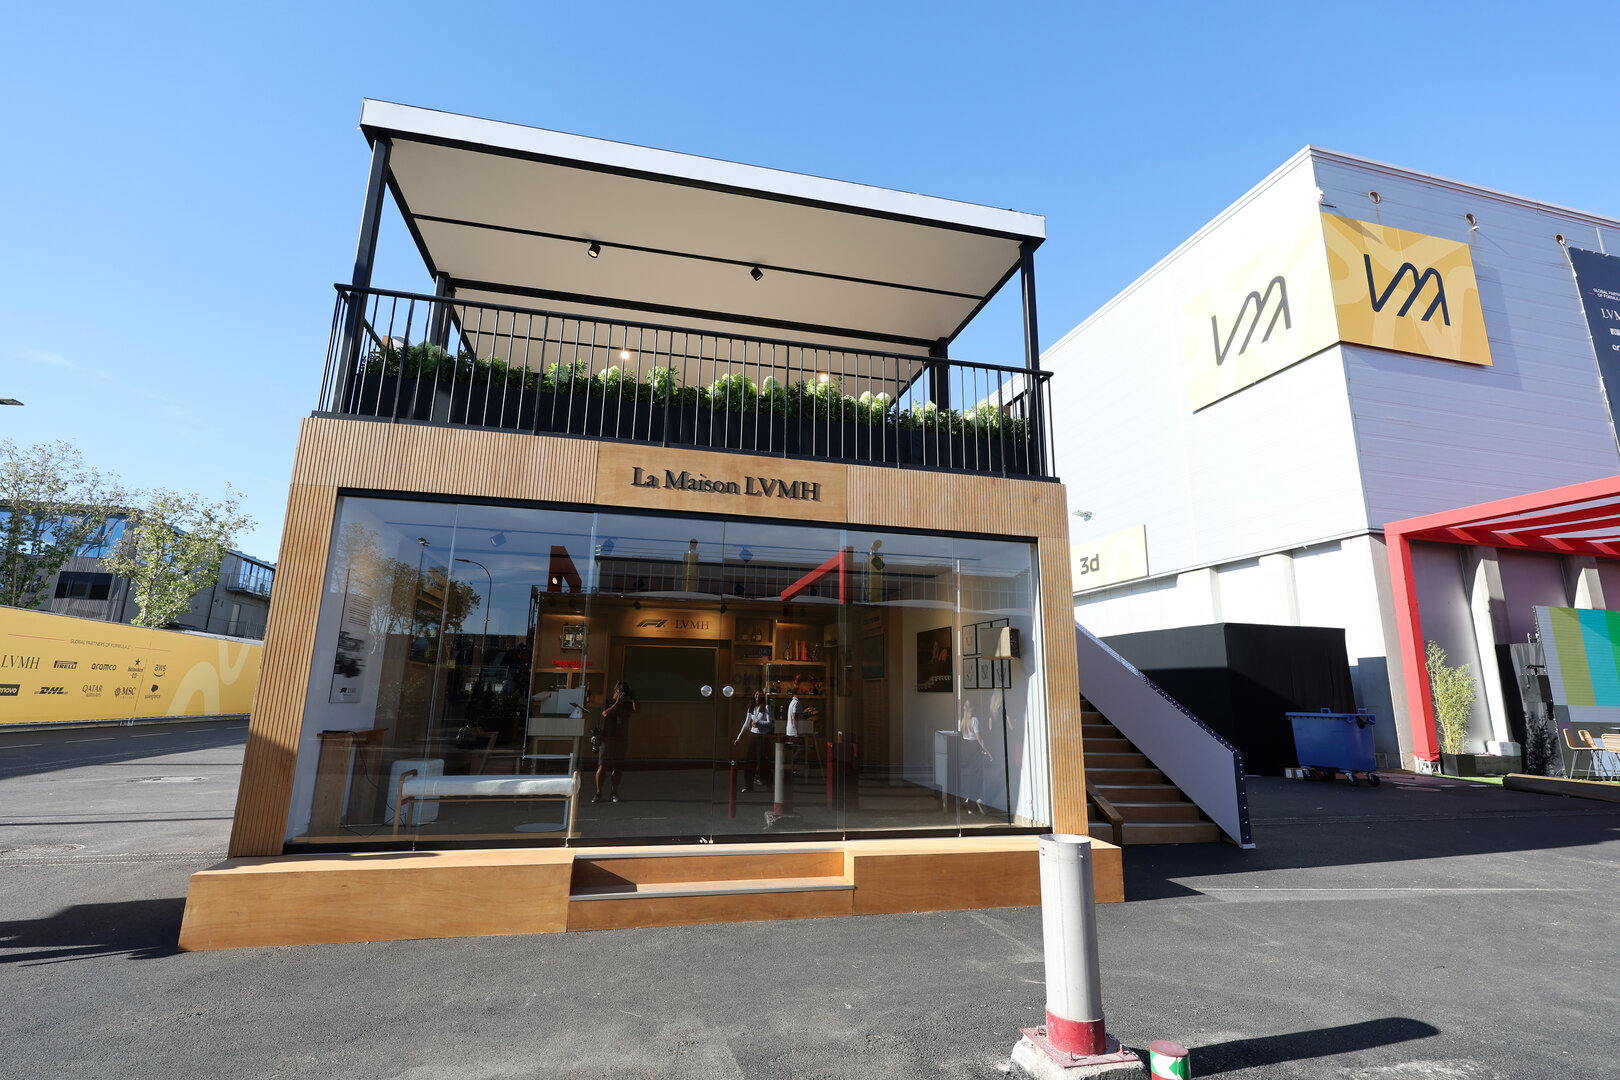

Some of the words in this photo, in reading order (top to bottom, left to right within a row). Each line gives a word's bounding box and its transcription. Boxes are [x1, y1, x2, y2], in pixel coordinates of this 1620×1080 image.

[631, 467, 659, 488] La
[664, 469, 740, 495] Maison
[744, 476, 822, 501] LVMH
[1080, 553, 1100, 575] 3d
[675, 619, 710, 630] LVMH
[1, 654, 40, 669] LVMH
[53, 660, 78, 669] PIRELLI
[91, 663, 117, 671] aramco
[154, 664, 166, 672] aws
[82, 684, 103, 693] QATAR
[121, 687, 136, 696] MSC
